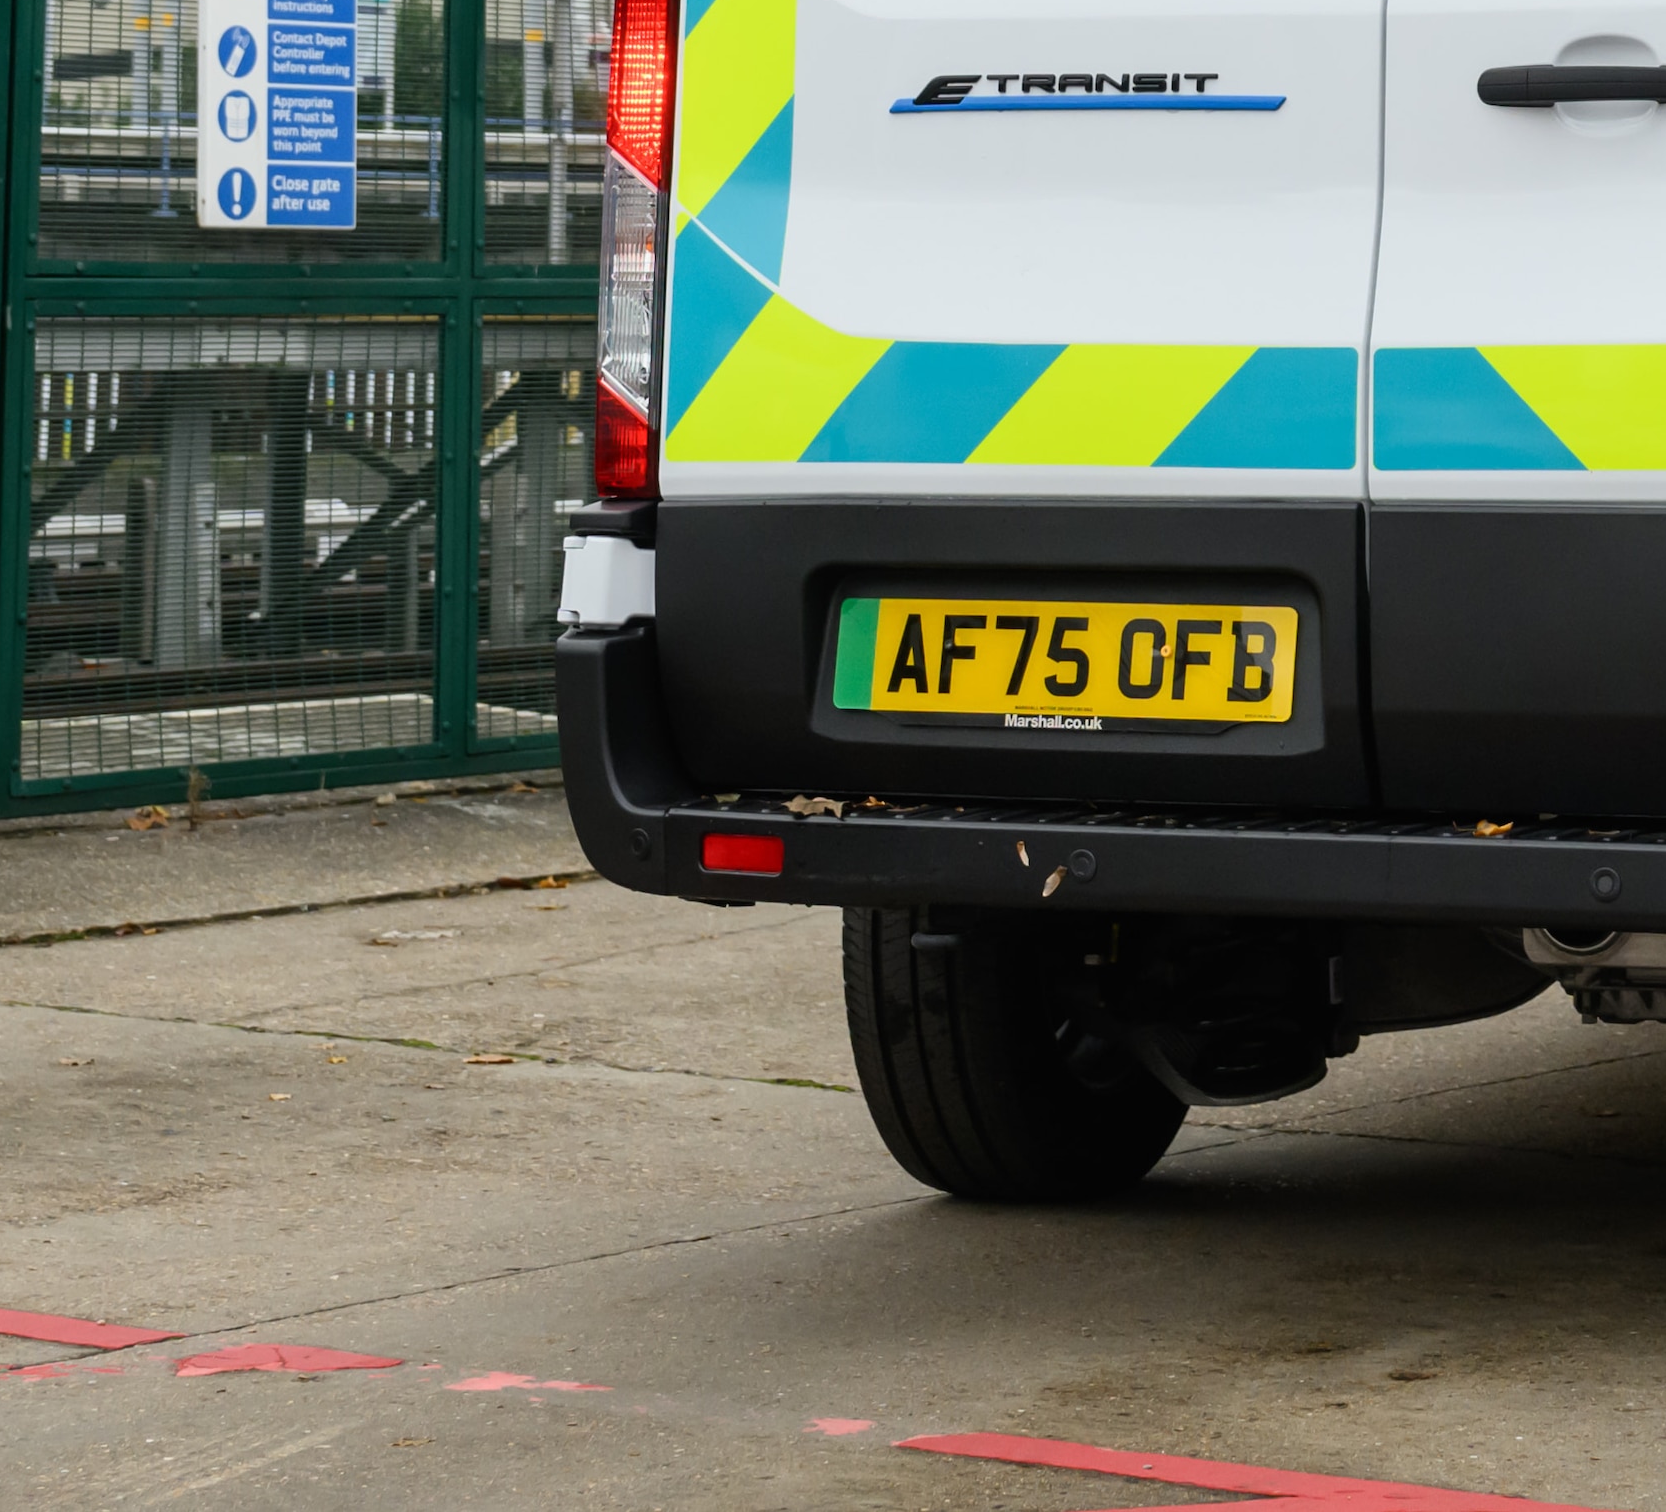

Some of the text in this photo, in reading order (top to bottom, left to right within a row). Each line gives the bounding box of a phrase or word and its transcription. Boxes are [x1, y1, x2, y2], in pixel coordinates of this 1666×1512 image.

[273, 31, 347, 49] Contact Depot
[273, 45, 325, 60] Controller
[274, 60, 351, 80] before entering
[273, 95, 334, 110] Appropriate
[273, 109, 336, 124] PPE must be
[273, 125, 339, 140] worn beyond
[273, 139, 322, 154] this point
[272, 174, 341, 195] Close gate
[272, 194, 331, 212] after use
[886, 613, 1277, 703] AF75 OFB
[1004, 713, 1103, 731] Marshall.co.uk
